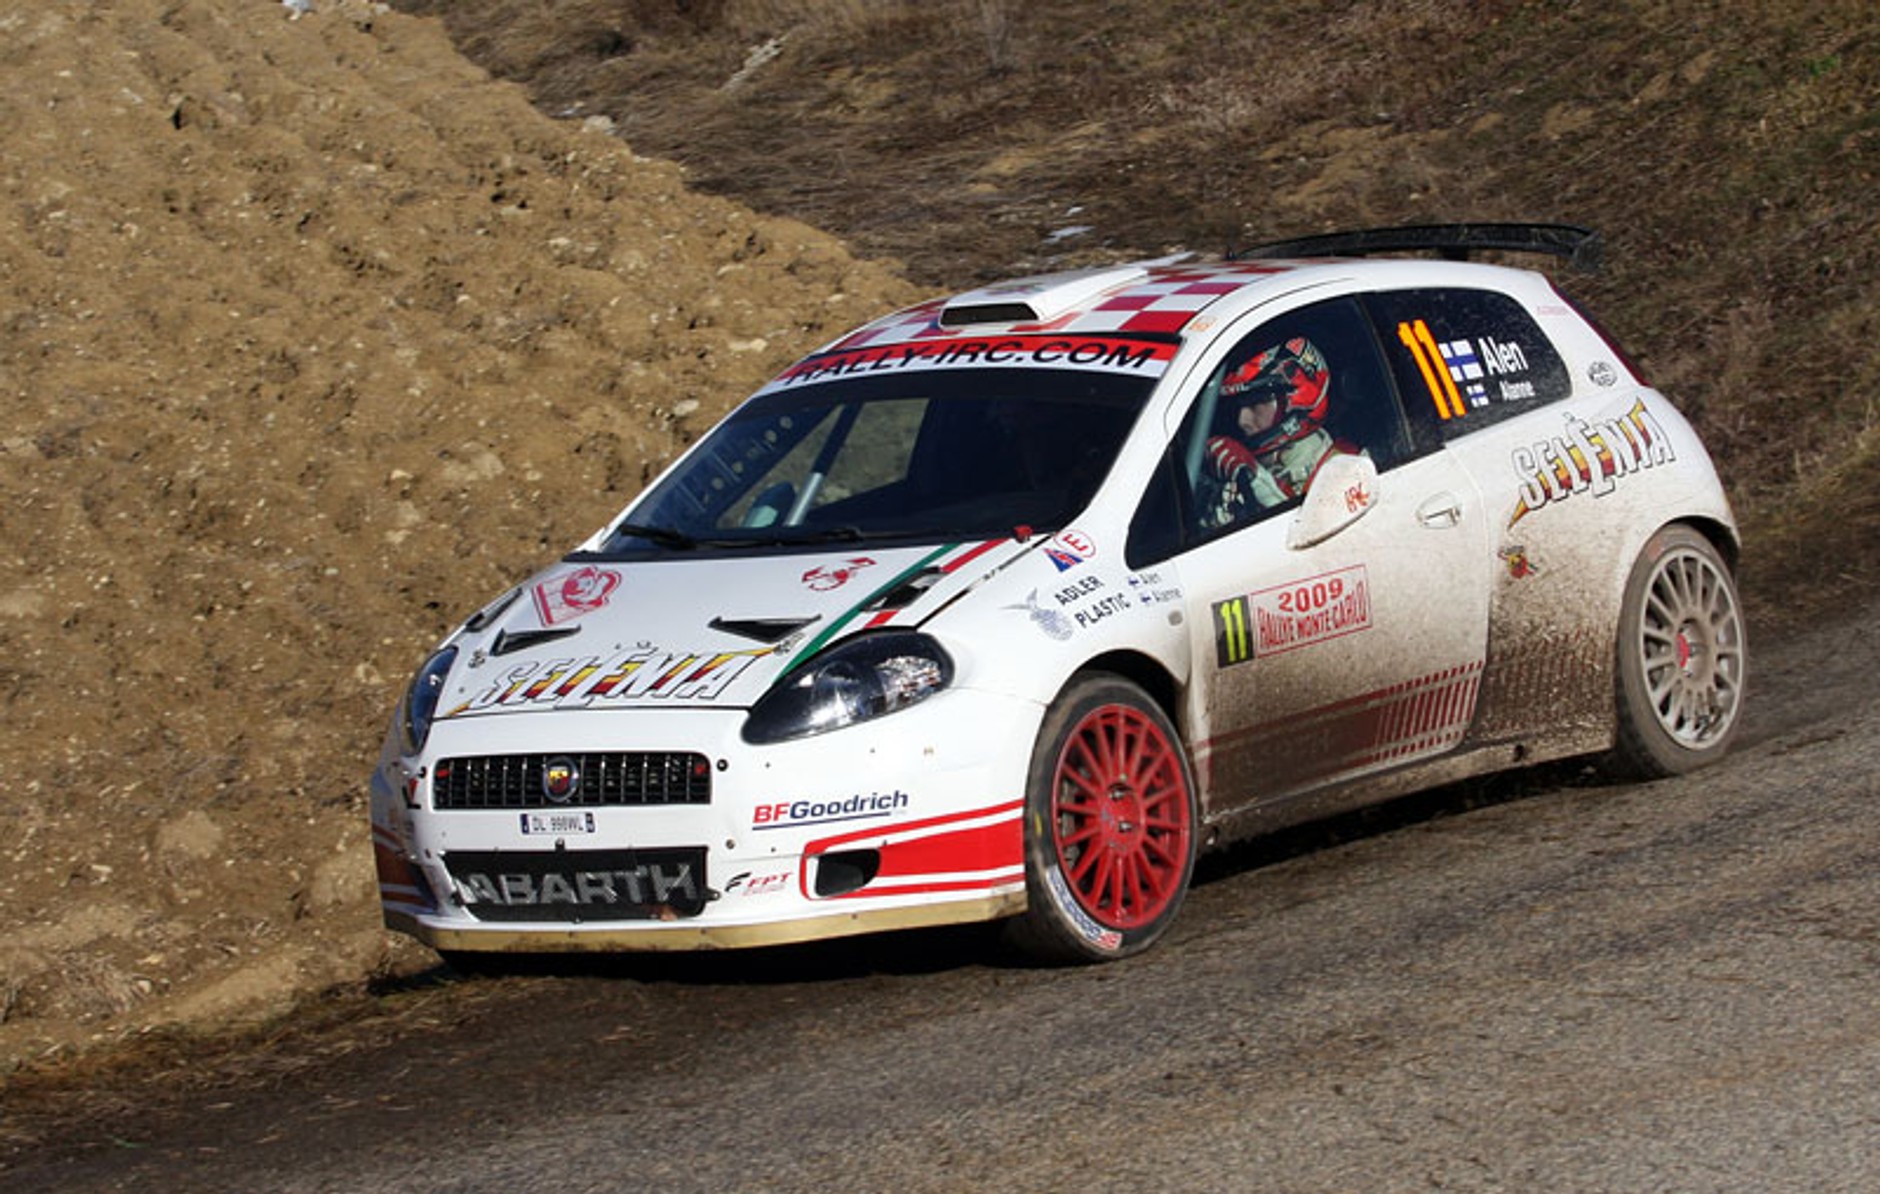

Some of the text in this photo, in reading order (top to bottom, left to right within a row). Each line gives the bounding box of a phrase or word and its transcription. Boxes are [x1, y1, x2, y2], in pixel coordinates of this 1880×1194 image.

[784, 339, 1156, 387] RALLY-IRC.COM
[1397, 319, 1468, 420] 11
[1478, 336, 1529, 376] Alen
[1054, 576, 1105, 606] ADLER
[1074, 592, 1131, 628] PLASTIC
[1278, 577, 1344, 612] 2009
[1220, 598, 1248, 662] 11
[752, 789, 909, 823] BFGoodrich
[456, 863, 698, 906] ABARTH
